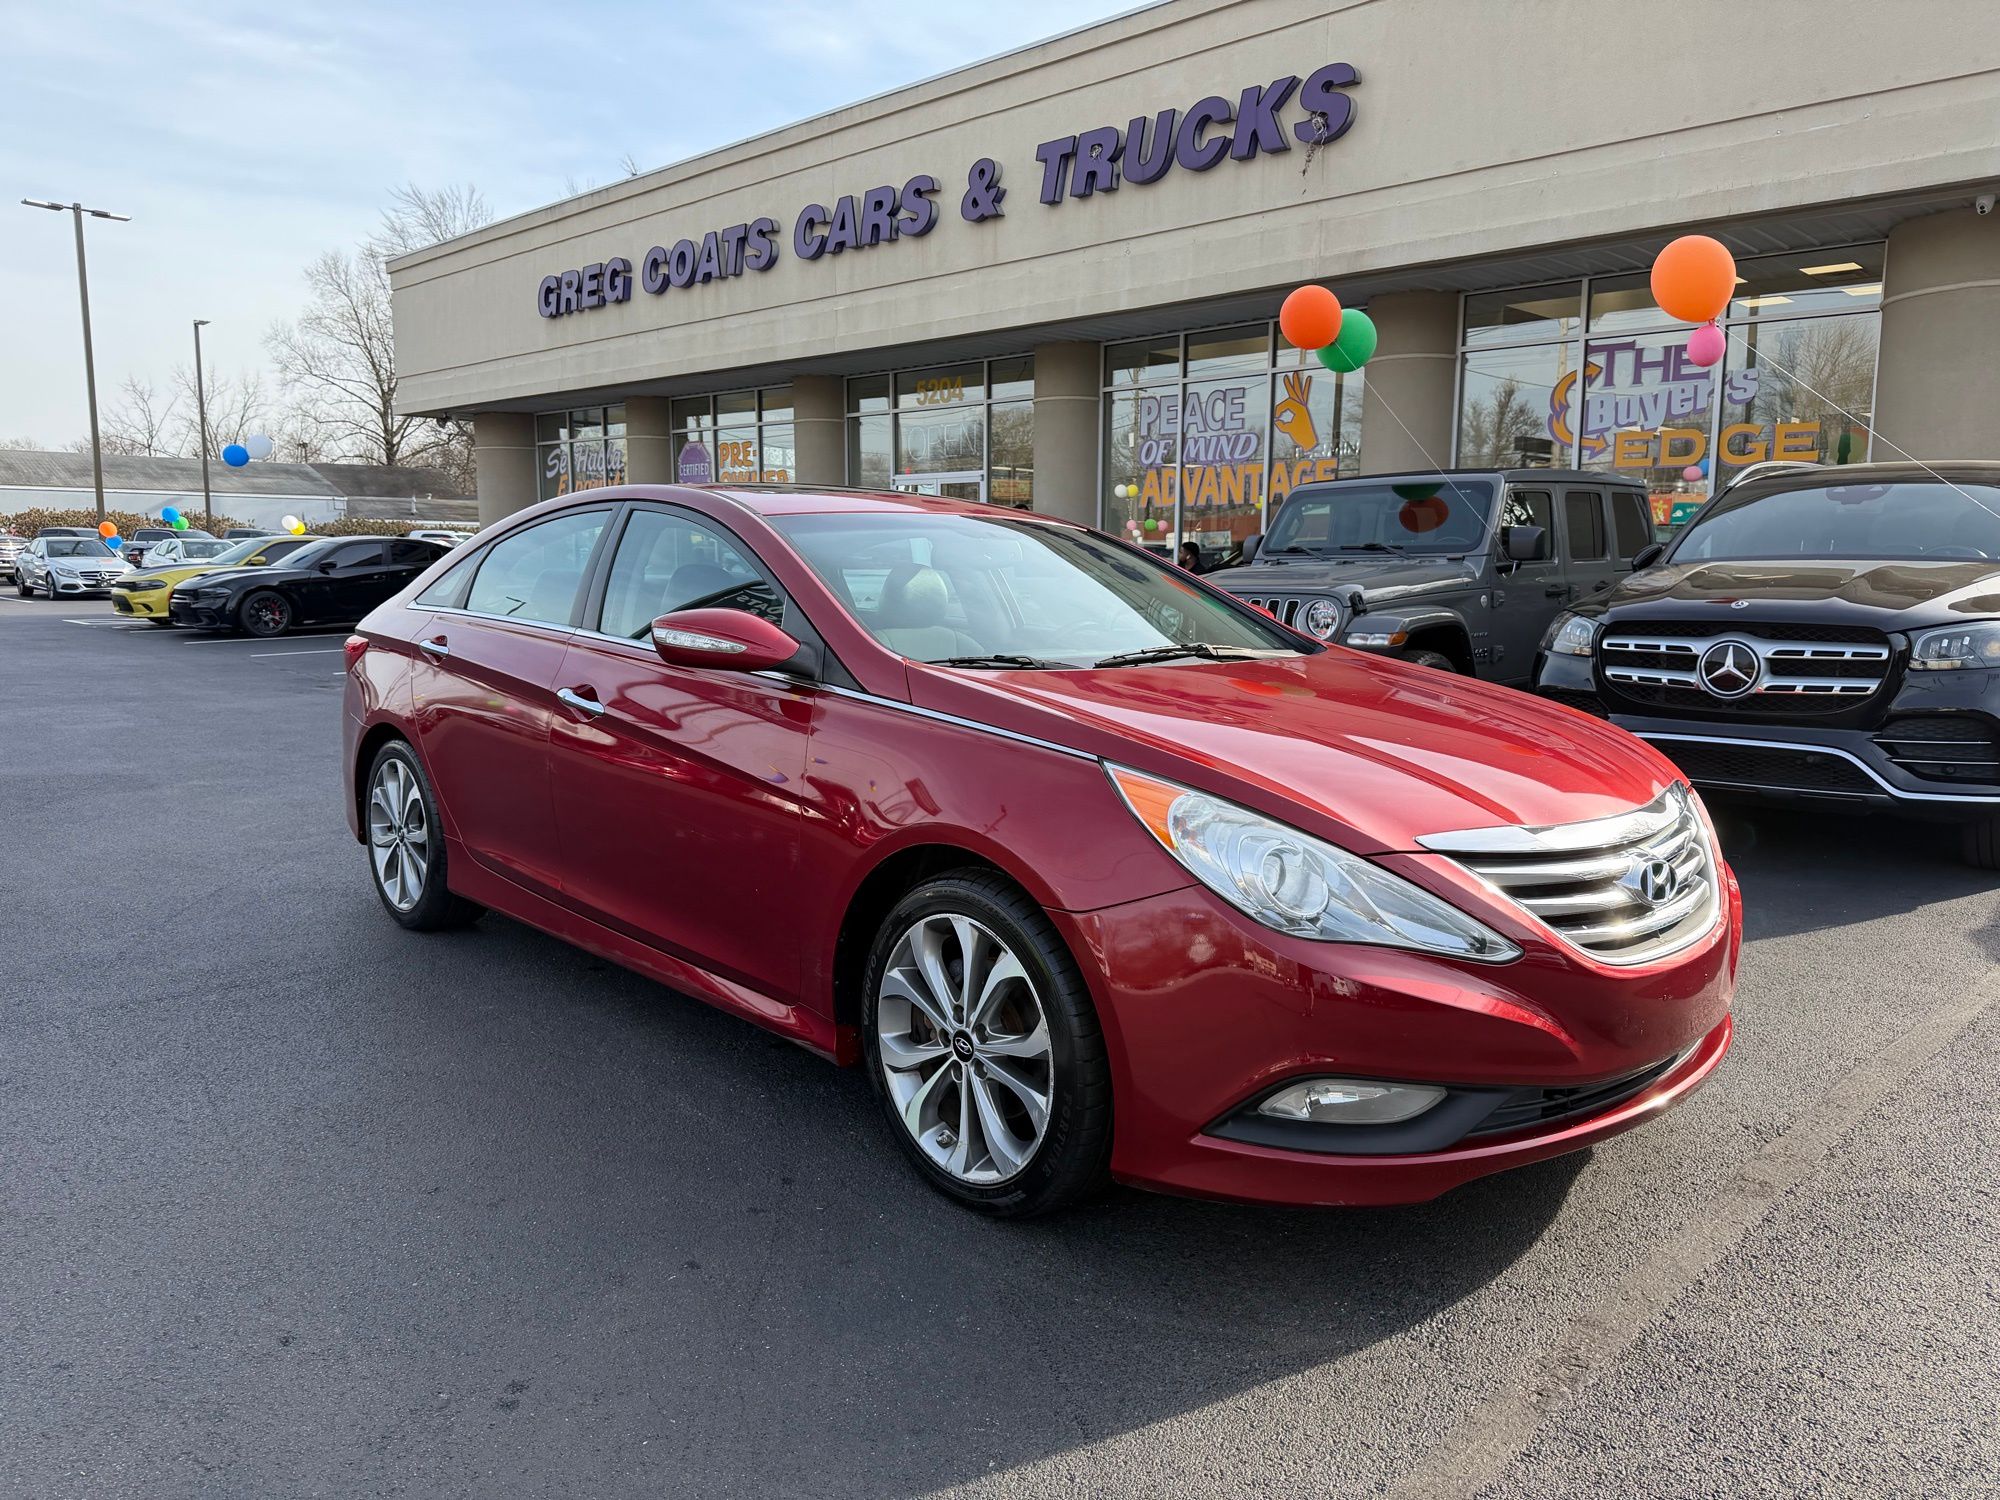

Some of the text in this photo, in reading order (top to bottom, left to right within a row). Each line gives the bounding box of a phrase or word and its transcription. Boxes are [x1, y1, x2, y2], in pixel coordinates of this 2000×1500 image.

[538, 62, 1362, 318] GREG COATS CARS & TRUCKS
[1588, 340, 1711, 387] THE
[916, 376, 963, 406] 5204
[1140, 387, 1246, 437] PEACE
[719, 441, 757, 468] PRE-
[907, 421, 979, 462] OPEN
[1140, 432, 1260, 466] OF MIND
[1613, 421, 1821, 468] EDGE
[546, 448, 568, 478] Se
[680, 463, 709, 476] CERTIFIED
[1139, 457, 1338, 509] ADVANTAGE
